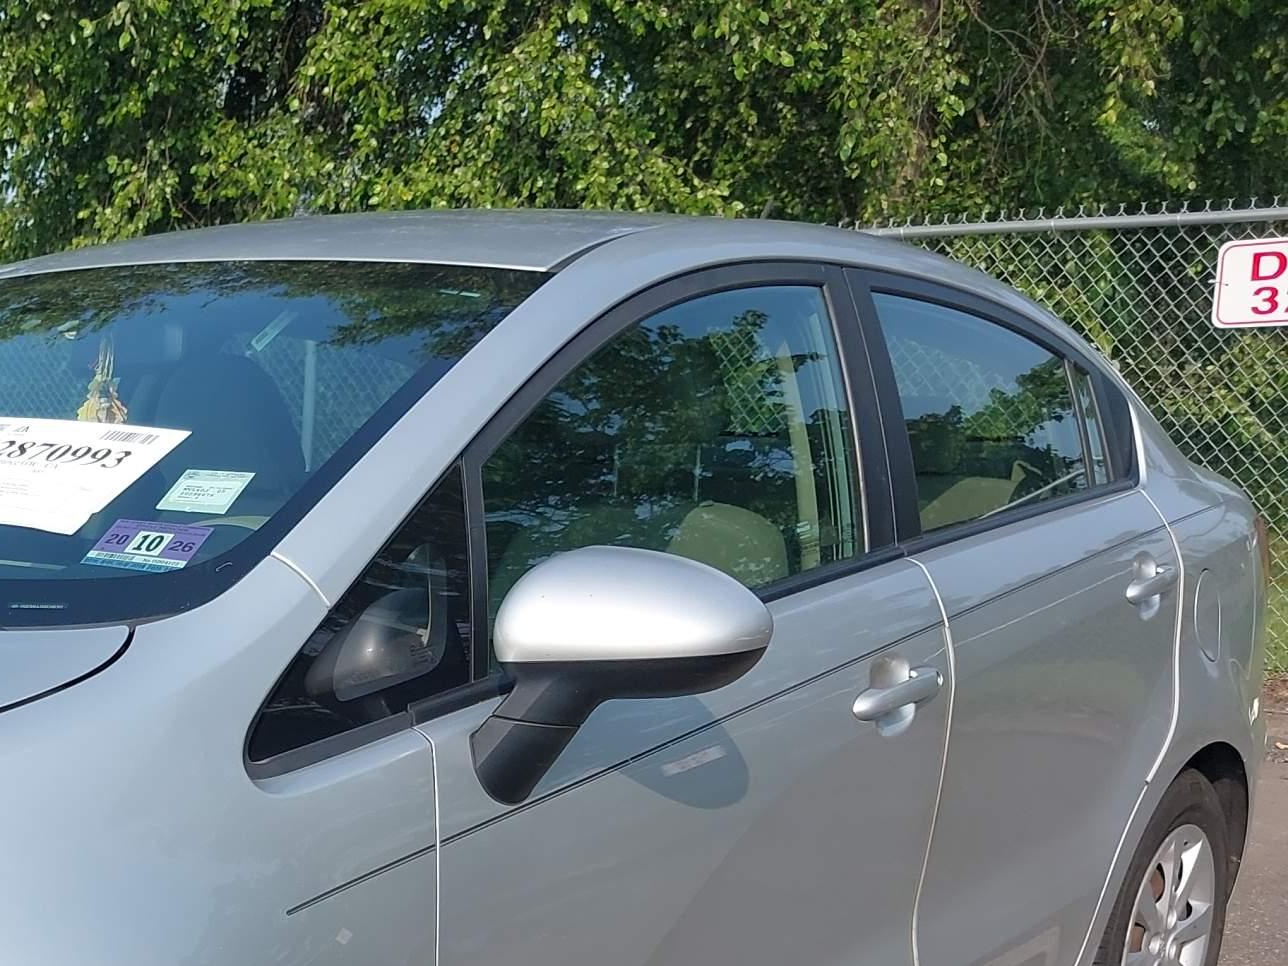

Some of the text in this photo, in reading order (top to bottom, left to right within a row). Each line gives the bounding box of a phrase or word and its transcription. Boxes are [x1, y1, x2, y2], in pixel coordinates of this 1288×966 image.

[1250, 286, 1288, 315] 3
[105, 533, 196, 552] 20 10 26
